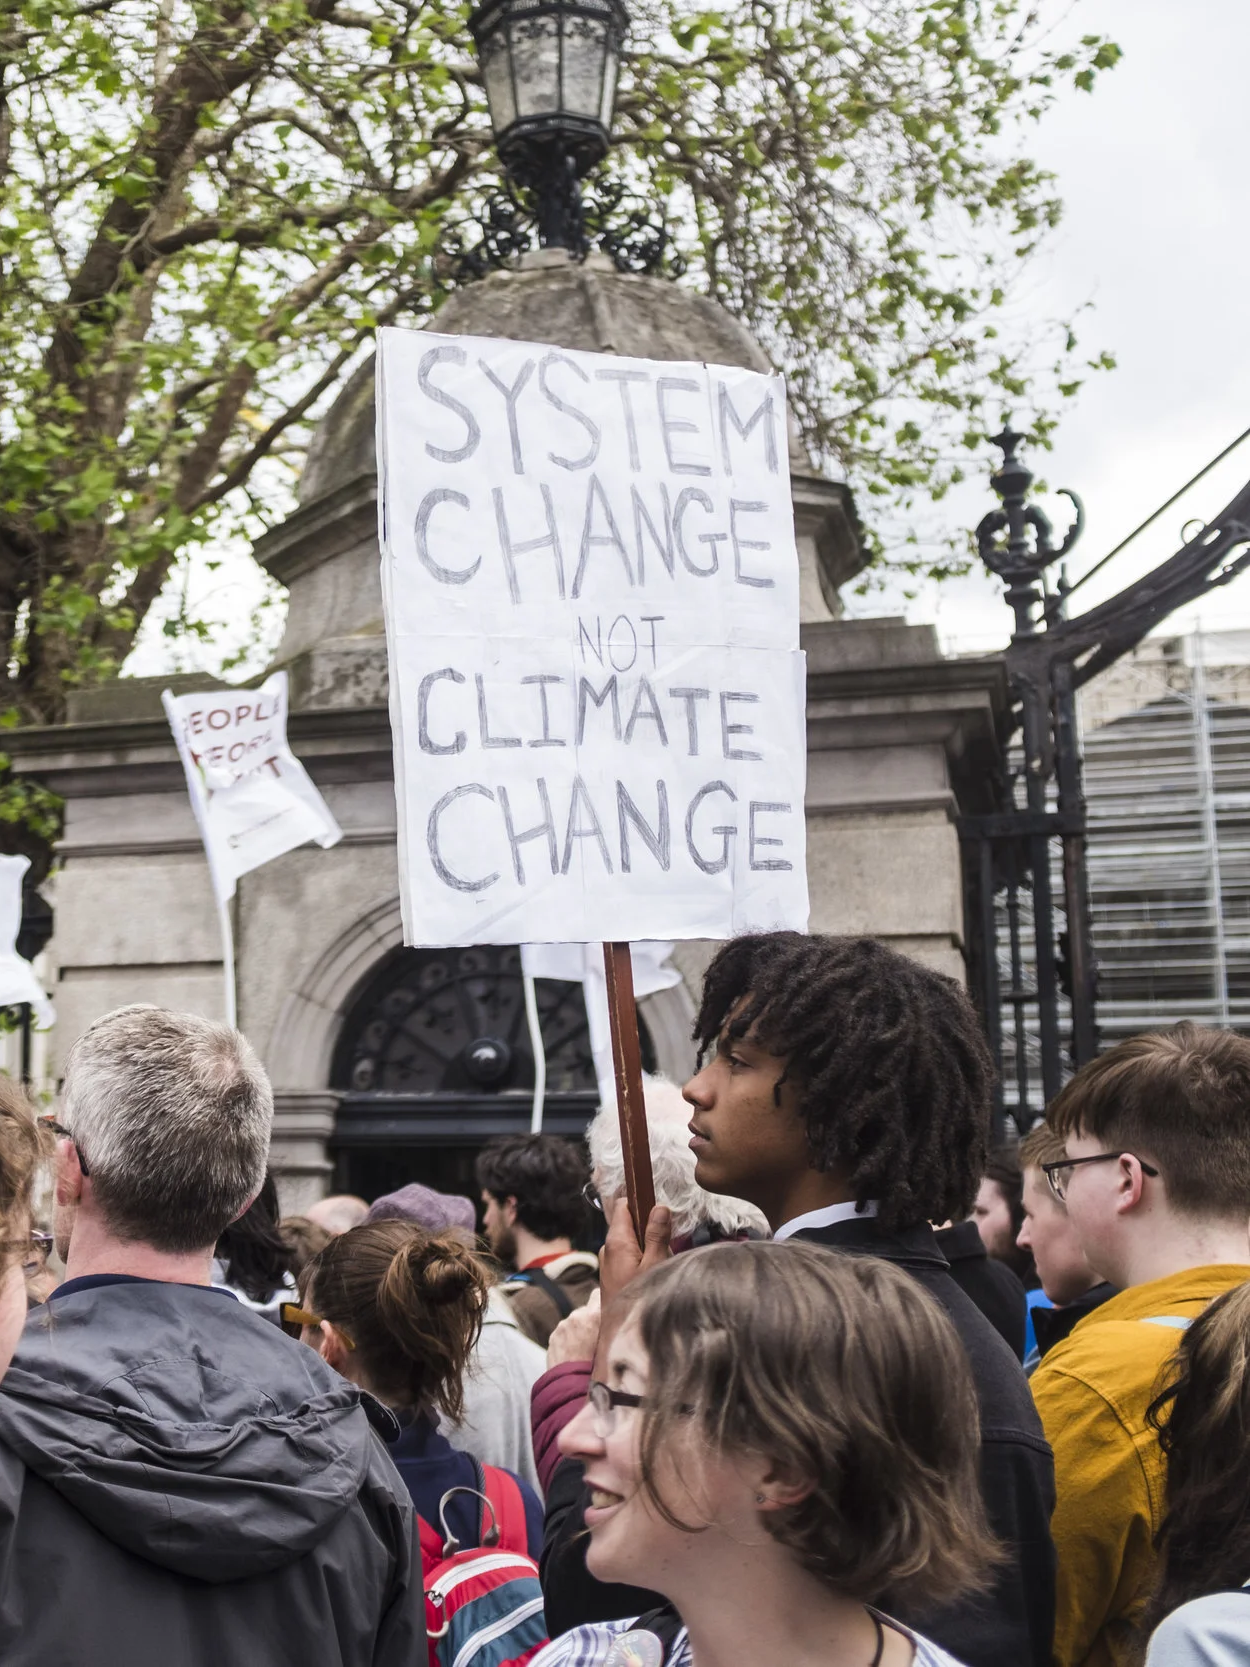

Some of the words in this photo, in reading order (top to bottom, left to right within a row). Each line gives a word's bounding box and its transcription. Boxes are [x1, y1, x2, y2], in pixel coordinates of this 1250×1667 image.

[416, 345, 779, 476] SYSTEM
[414, 473, 776, 604] CHANGE
[577, 614, 665, 672] NOT
[417, 667, 763, 762] CLIMATE
[427, 774, 793, 894] CHANGE
